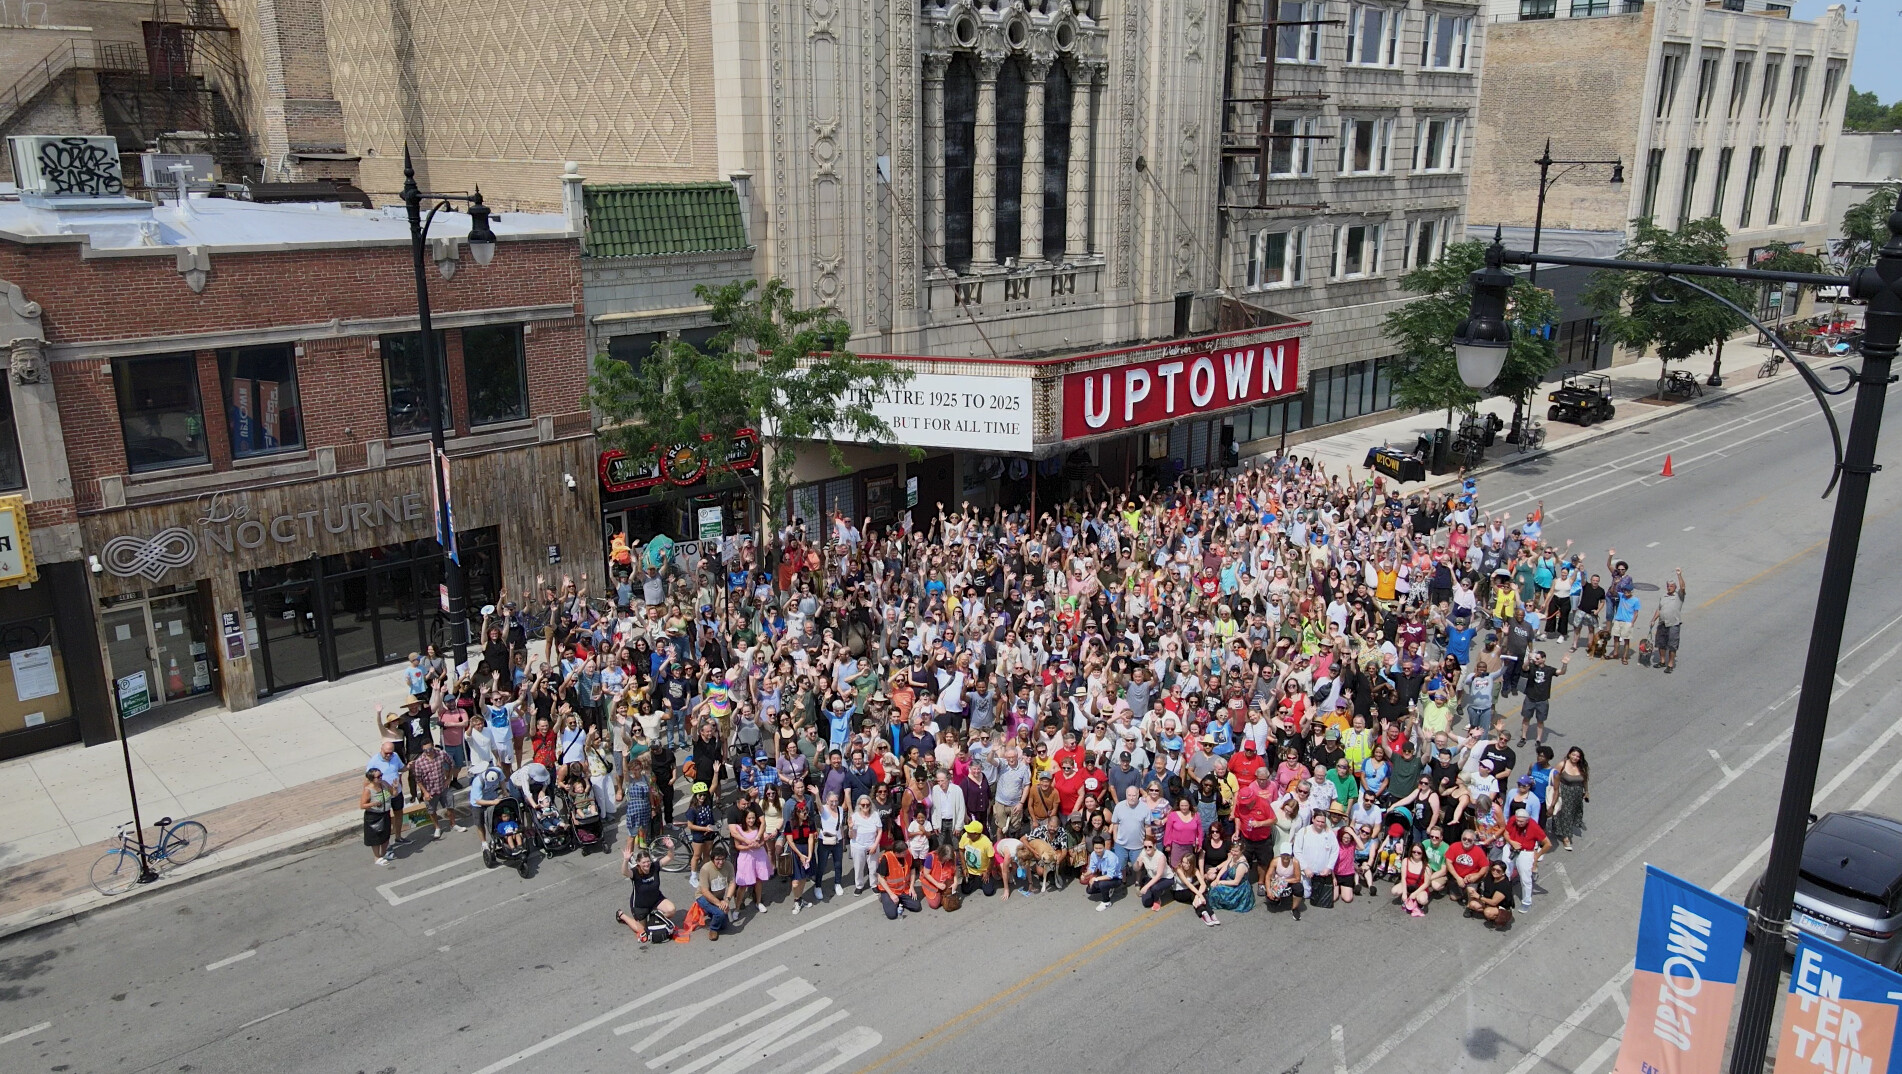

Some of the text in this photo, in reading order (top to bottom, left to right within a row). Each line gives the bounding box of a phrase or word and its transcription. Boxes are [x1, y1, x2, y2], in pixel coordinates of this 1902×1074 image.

[848, 388, 924, 406] THEATRE
[929, 391, 958, 408] 1925
[962, 393, 985, 409] TO
[989, 394, 1020, 411] 2025
[1084, 345, 1285, 428] UPTOWN
[893, 416, 921, 429] BUT
[923, 417, 951, 431] FOR
[955, 420, 981, 433] ALL
[984, 421, 1020, 435] TIME
[196, 492, 250, 526] Le
[203, 493, 424, 556] NOCTURNE
[1653, 904, 1713, 1051] UPTOWN
[1795, 987, 1862, 1051] TER
